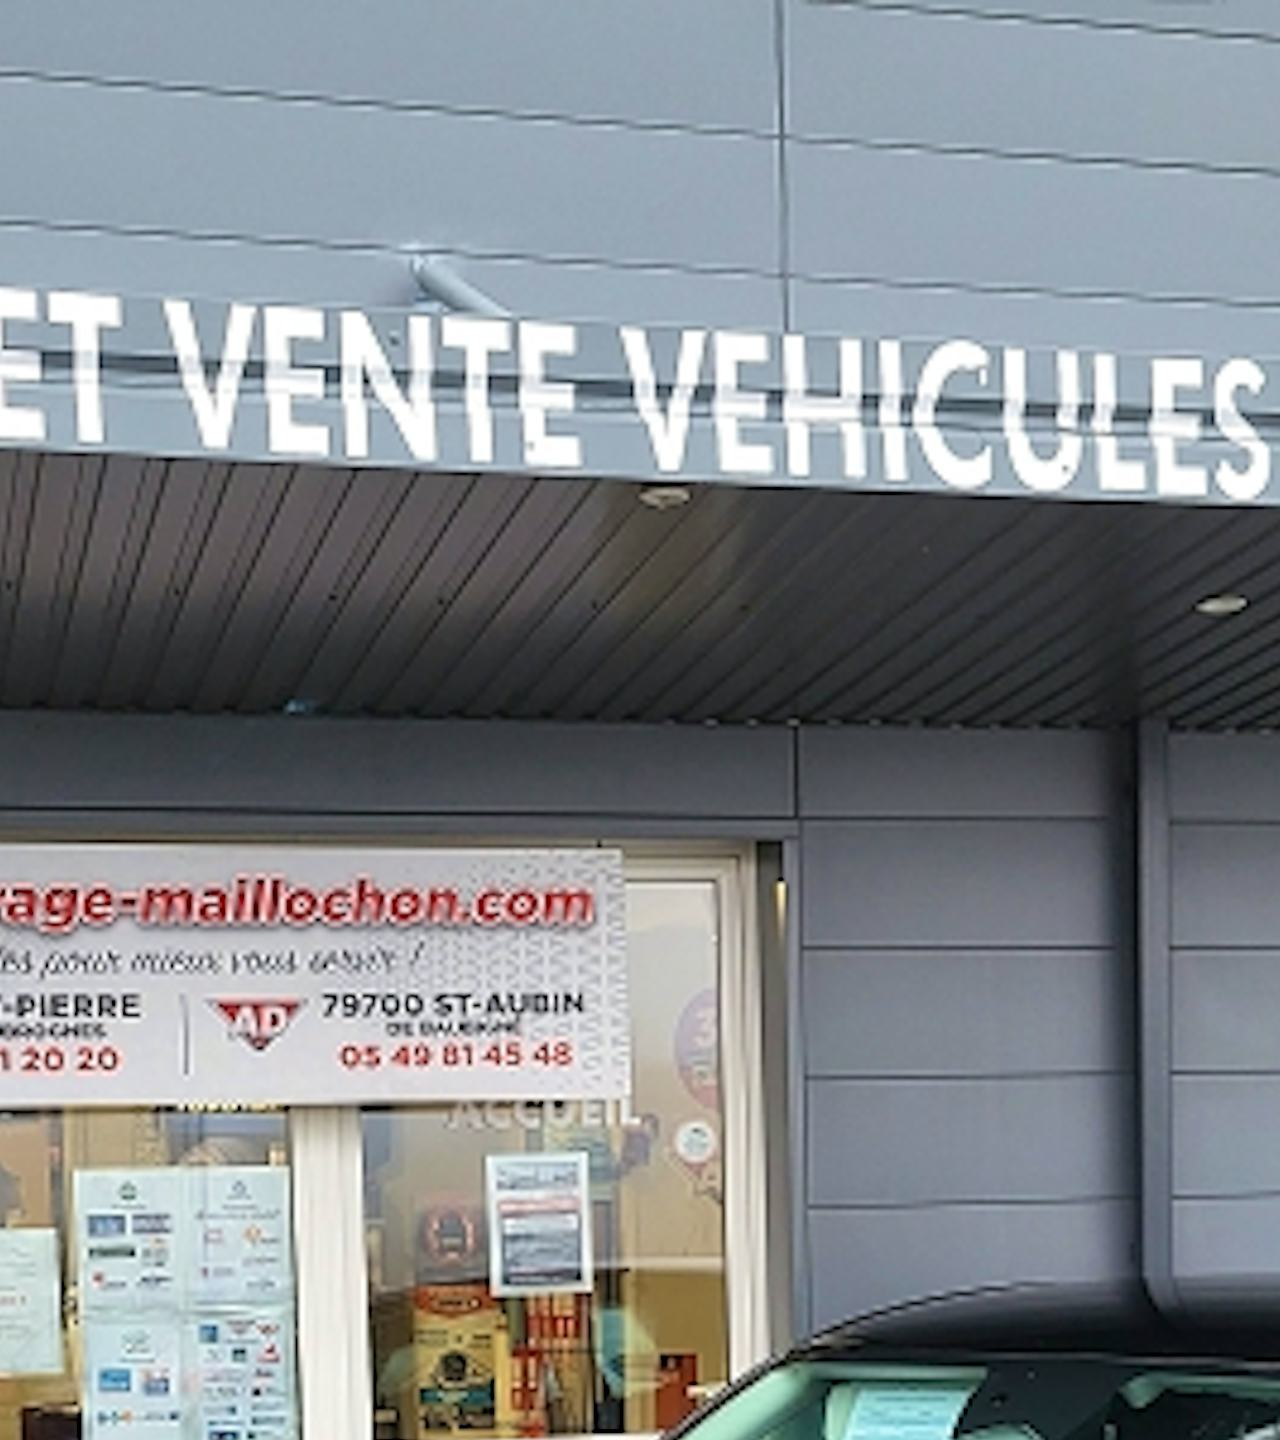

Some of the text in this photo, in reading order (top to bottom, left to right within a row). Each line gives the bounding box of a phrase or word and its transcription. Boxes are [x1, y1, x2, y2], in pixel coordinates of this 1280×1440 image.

[163, 299, 583, 469] VENTE
[619, 326, 1272, 500] VEHICULES
[322, 994, 585, 1017] 79700 ST-AUBIN
[232, 1004, 288, 1034] AD
[22, 1049, 63, 1072] 20
[78, 1048, 119, 1072] 20
[340, 1043, 573, 1069] 05 49 81 45 48
